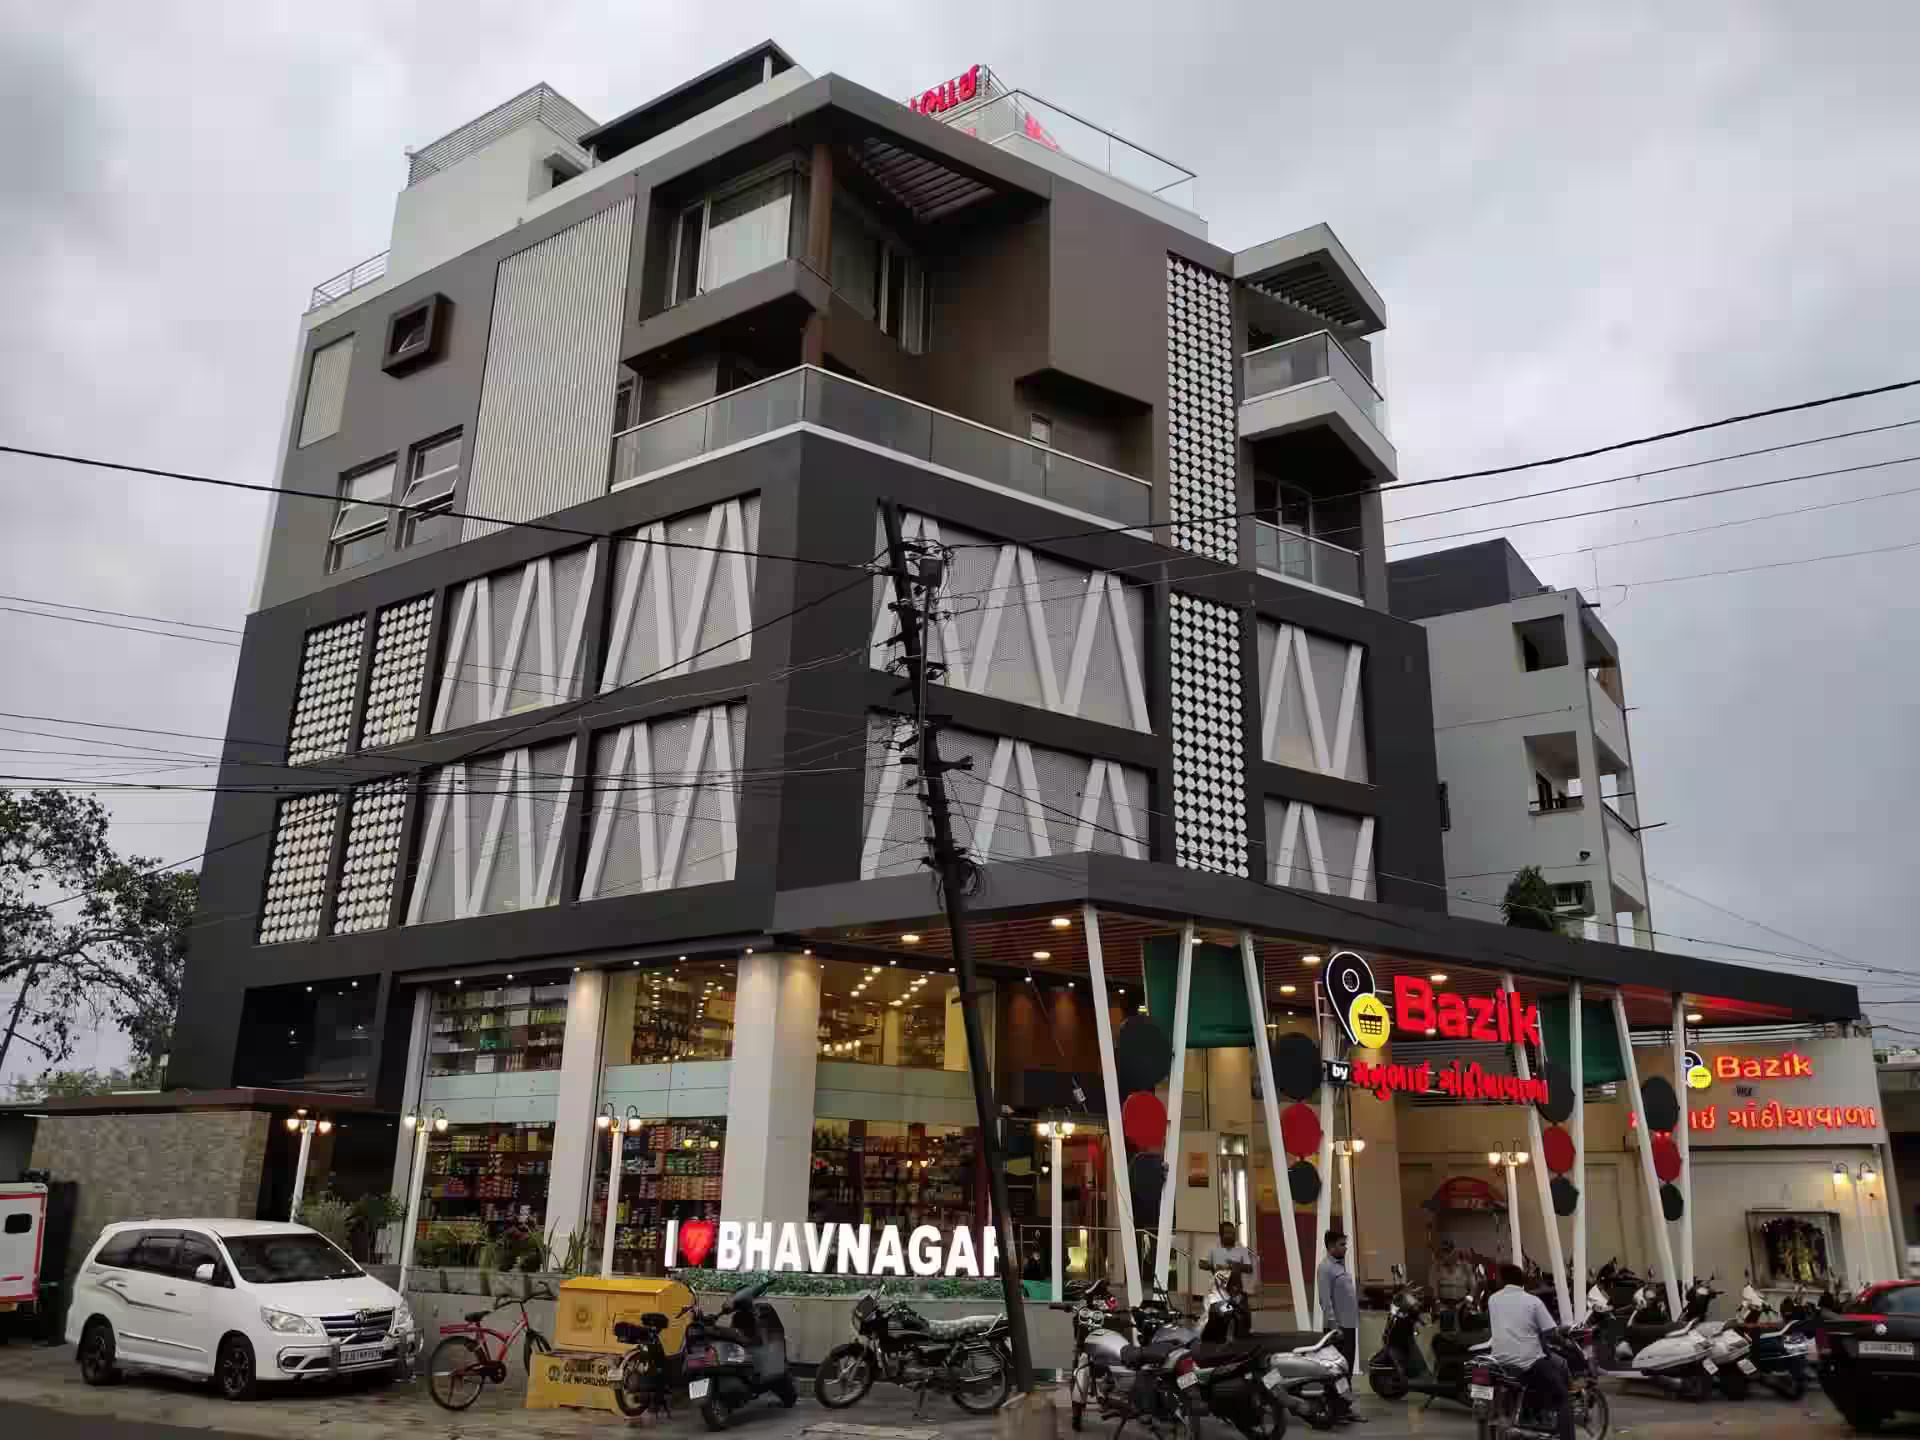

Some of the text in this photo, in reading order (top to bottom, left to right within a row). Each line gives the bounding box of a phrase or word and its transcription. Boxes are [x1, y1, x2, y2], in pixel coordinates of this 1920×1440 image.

[1394, 975, 1541, 1048] Bazik
[1332, 1064, 1348, 1080] by
[1716, 1053, 1813, 1079] Bazik
[665, 1220, 679, 1267] I
